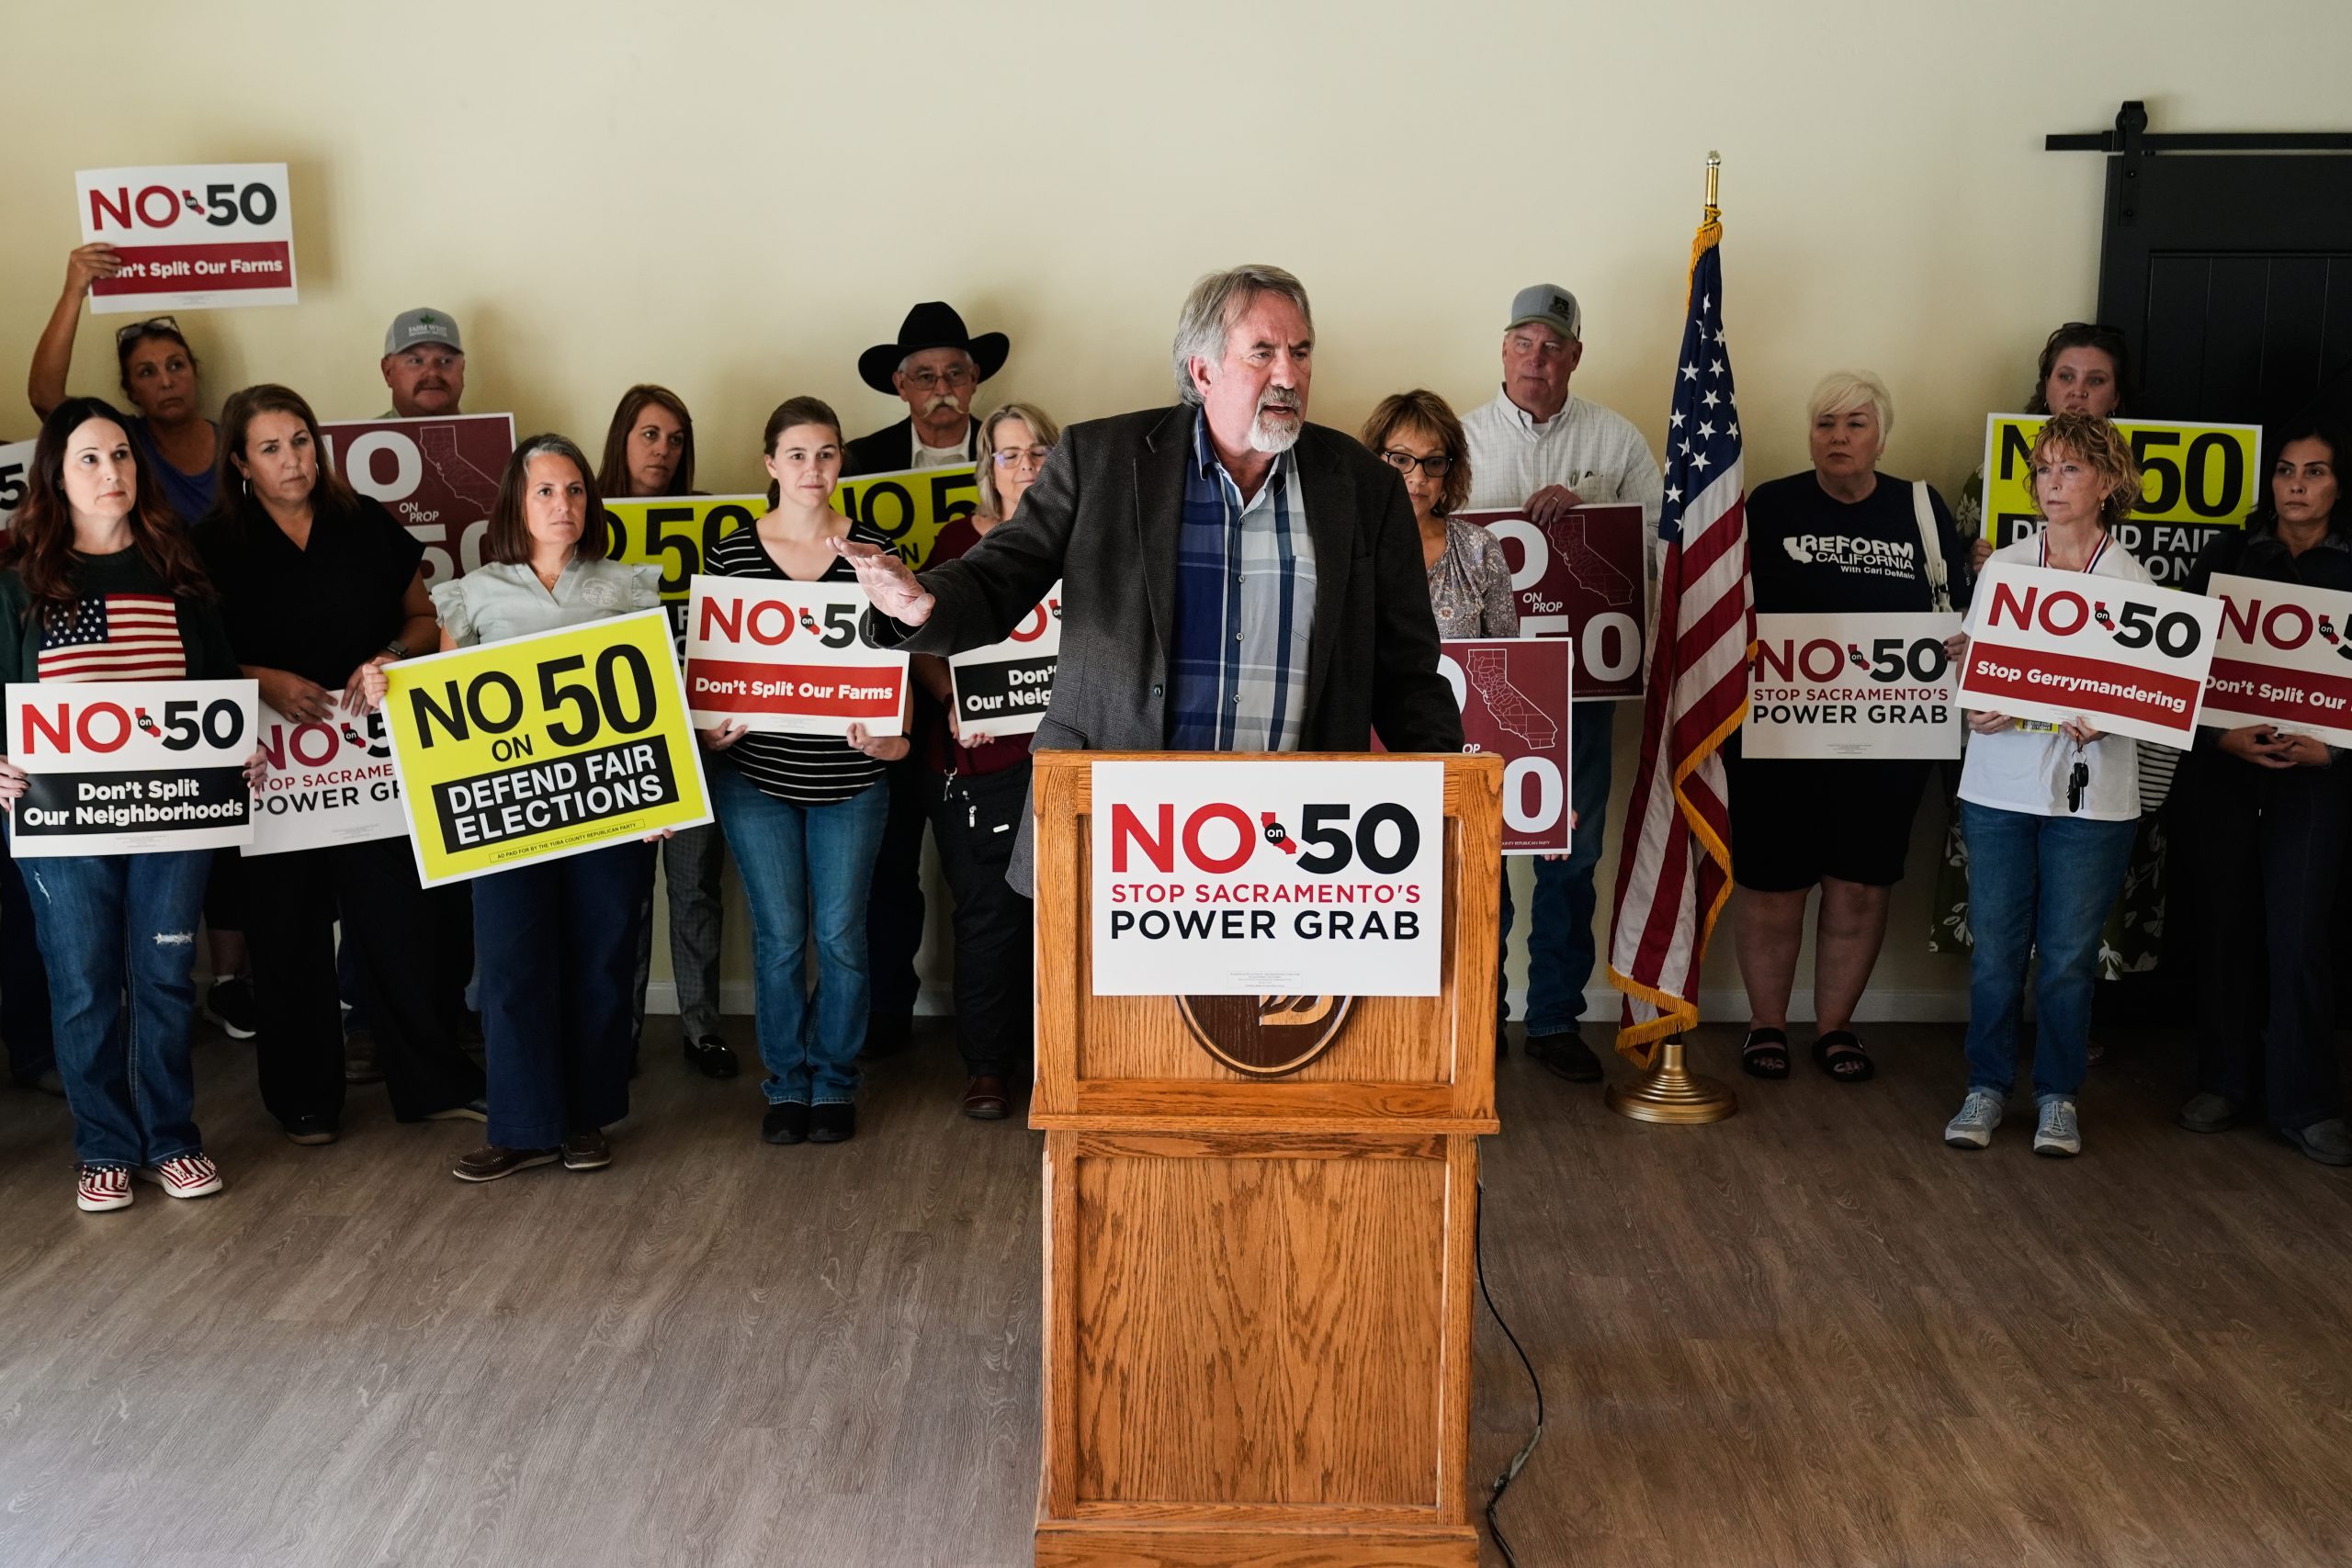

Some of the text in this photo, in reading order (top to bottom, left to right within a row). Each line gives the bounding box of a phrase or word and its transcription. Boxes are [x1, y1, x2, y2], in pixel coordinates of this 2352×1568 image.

[89, 185, 180, 231] NO
[206, 182, 277, 226] 50
[150, 261, 190, 279] Split
[195, 260, 227, 275] Our
[232, 258, 283, 274] Farms
[2131, 430, 2244, 518] 50
[399, 502, 419, 513] ON
[409, 511, 439, 523] PROP
[1801, 534, 1914, 559] REFORM
[1815, 551, 1914, 570] CALIFORNIA
[1863, 567, 1883, 575] Carl
[1522, 592, 1543, 604] ON
[1532, 602, 1563, 614] PROP
[699, 596, 795, 646] NO
[802, 616, 813, 625] on
[1987, 582, 2089, 637] NO
[2112, 601, 2201, 659] 50
[2217, 594, 2313, 650] NO
[1754, 638, 1845, 682] NO
[1869, 637, 1949, 682] 50
[409, 644, 657, 749] NO 50
[695, 677, 893, 700] Don't Split Our Farms
[1754, 689, 1949, 701] STOP SACRAMENTO'S
[1976, 660, 2187, 714] Stop Gerrymandering
[2259, 683, 2304, 704] Split
[2309, 692, 2346, 710] Our
[967, 694, 1004, 712] Our
[1753, 705, 1948, 724] POWER GRAB
[22, 699, 244, 754] NO on 50
[345, 731, 357, 739] on
[492, 734, 533, 762] ON
[302, 763, 393, 787] SACRAME
[448, 761, 578, 815] DEFEND
[585, 744, 656, 784] FAIR
[78, 779, 199, 801] Don't Split
[24, 799, 243, 827] Our Neighborhoods
[455, 774, 663, 845] ELECTIONS
[565, 834, 586, 843] COUNTY
[587, 827, 619, 839] REPUBLICAN
[620, 823, 636, 831] PARTY
[1112, 802, 1419, 874] NO on 50
[1112, 884, 1419, 903] STOP SACRAMENTO'S
[1112, 909, 1419, 940] POWER GRAB
